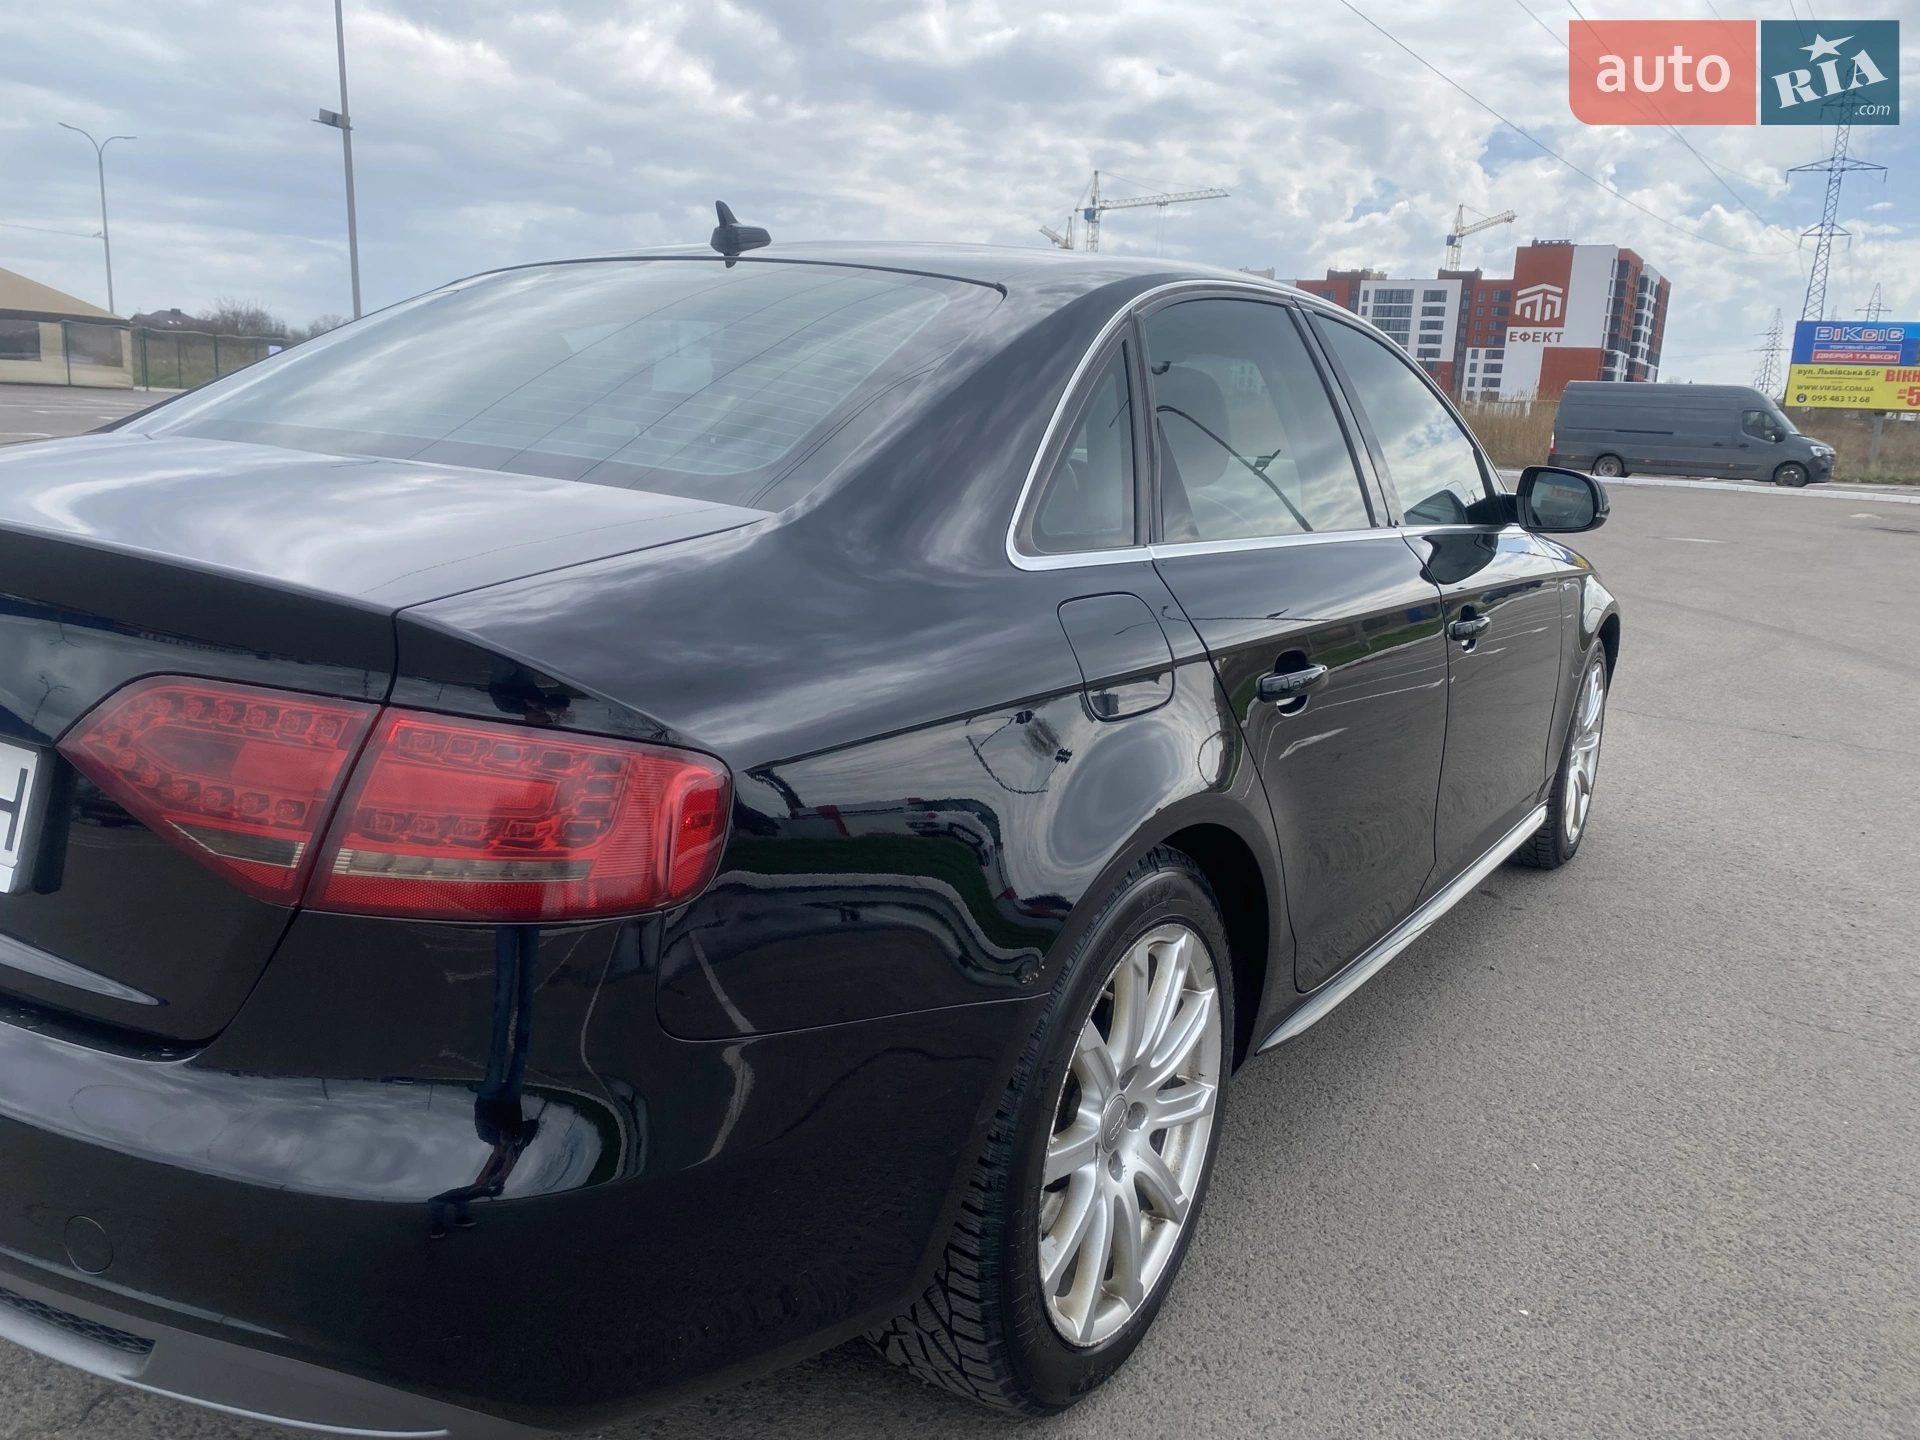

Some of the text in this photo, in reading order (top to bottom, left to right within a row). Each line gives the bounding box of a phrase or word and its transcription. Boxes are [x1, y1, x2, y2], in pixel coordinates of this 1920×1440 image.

[1508, 331, 1564, 343] ЕФЕКТ
[1797, 368, 1816, 376] вул.
[1817, 368, 1863, 376] Львівська
[1811, 394, 1828, 402] 095
